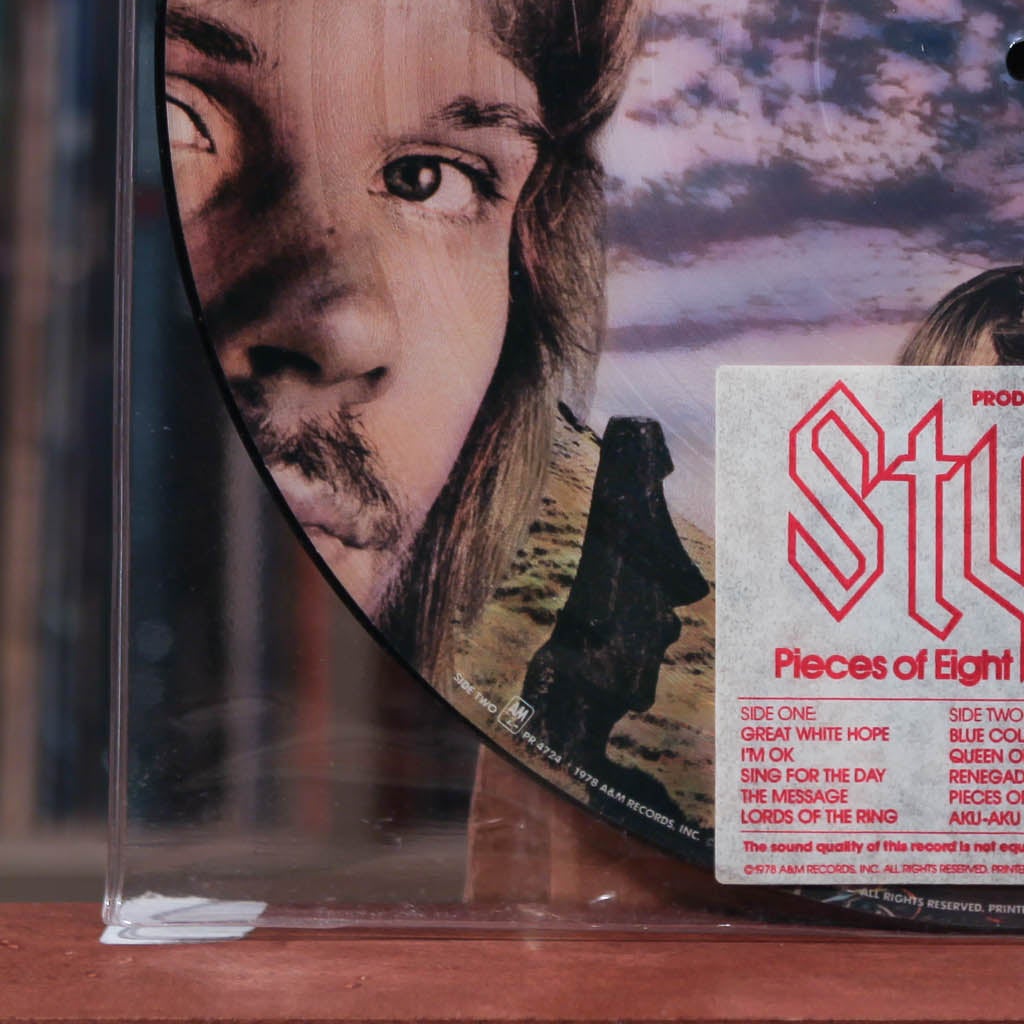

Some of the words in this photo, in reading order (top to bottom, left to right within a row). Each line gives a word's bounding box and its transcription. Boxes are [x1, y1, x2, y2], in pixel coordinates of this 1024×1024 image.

[774, 647, 888, 681] Pieces
[893, 648, 929, 681] of
[935, 648, 1015, 688] Eight
[453, 672, 476, 695] SIDE
[474, 692, 498, 713] TWO
[741, 705, 774, 721] SIDE
[949, 707, 982, 723] SIDE
[741, 726, 791, 742] GREAT
[795, 726, 843, 742] WHITE
[847, 726, 890, 742] HOPE
[949, 728, 985, 743] BLUE
[522, 731, 537, 745] PR
[536, 742, 562, 764] 4724
[741, 747, 765, 763] I'M
[769, 747, 795, 763] OK
[949, 748, 1004, 764] QUEEN
[740, 768, 783, 784] SING
[786, 768, 820, 784] FOR
[823, 768, 850, 784] THE
[854, 768, 887, 784] DAY
[573, 767, 599, 787] 1978
[600, 784, 626, 803] A&M
[741, 788, 768, 804] THE
[772, 788, 849, 804] MESSAGE
[949, 790, 1002, 805] PIECES
[741, 809, 795, 825] LORDS
[797, 809, 822, 825] OF
[824, 809, 853, 825] THE
[856, 809, 899, 825] RING
[949, 810, 1022, 826] AKU-AKU
[743, 840, 768, 853] The
[770, 840, 812, 853] sound
[816, 840, 864, 855] quality
[866, 840, 881, 853] of
[883, 840, 908, 853] this
[911, 841, 957, 853] record
[959, 841, 971, 853] is
[974, 841, 997, 853] not
[780, 864, 805, 874] A&M
[883, 864, 899, 874] ALL
[902, 864, 937, 874] RIGHTS
[859, 888, 880, 899] ALL
[883, 892, 925, 907] RIGHTS
[927, 899, 985, 913] RESERVED.
